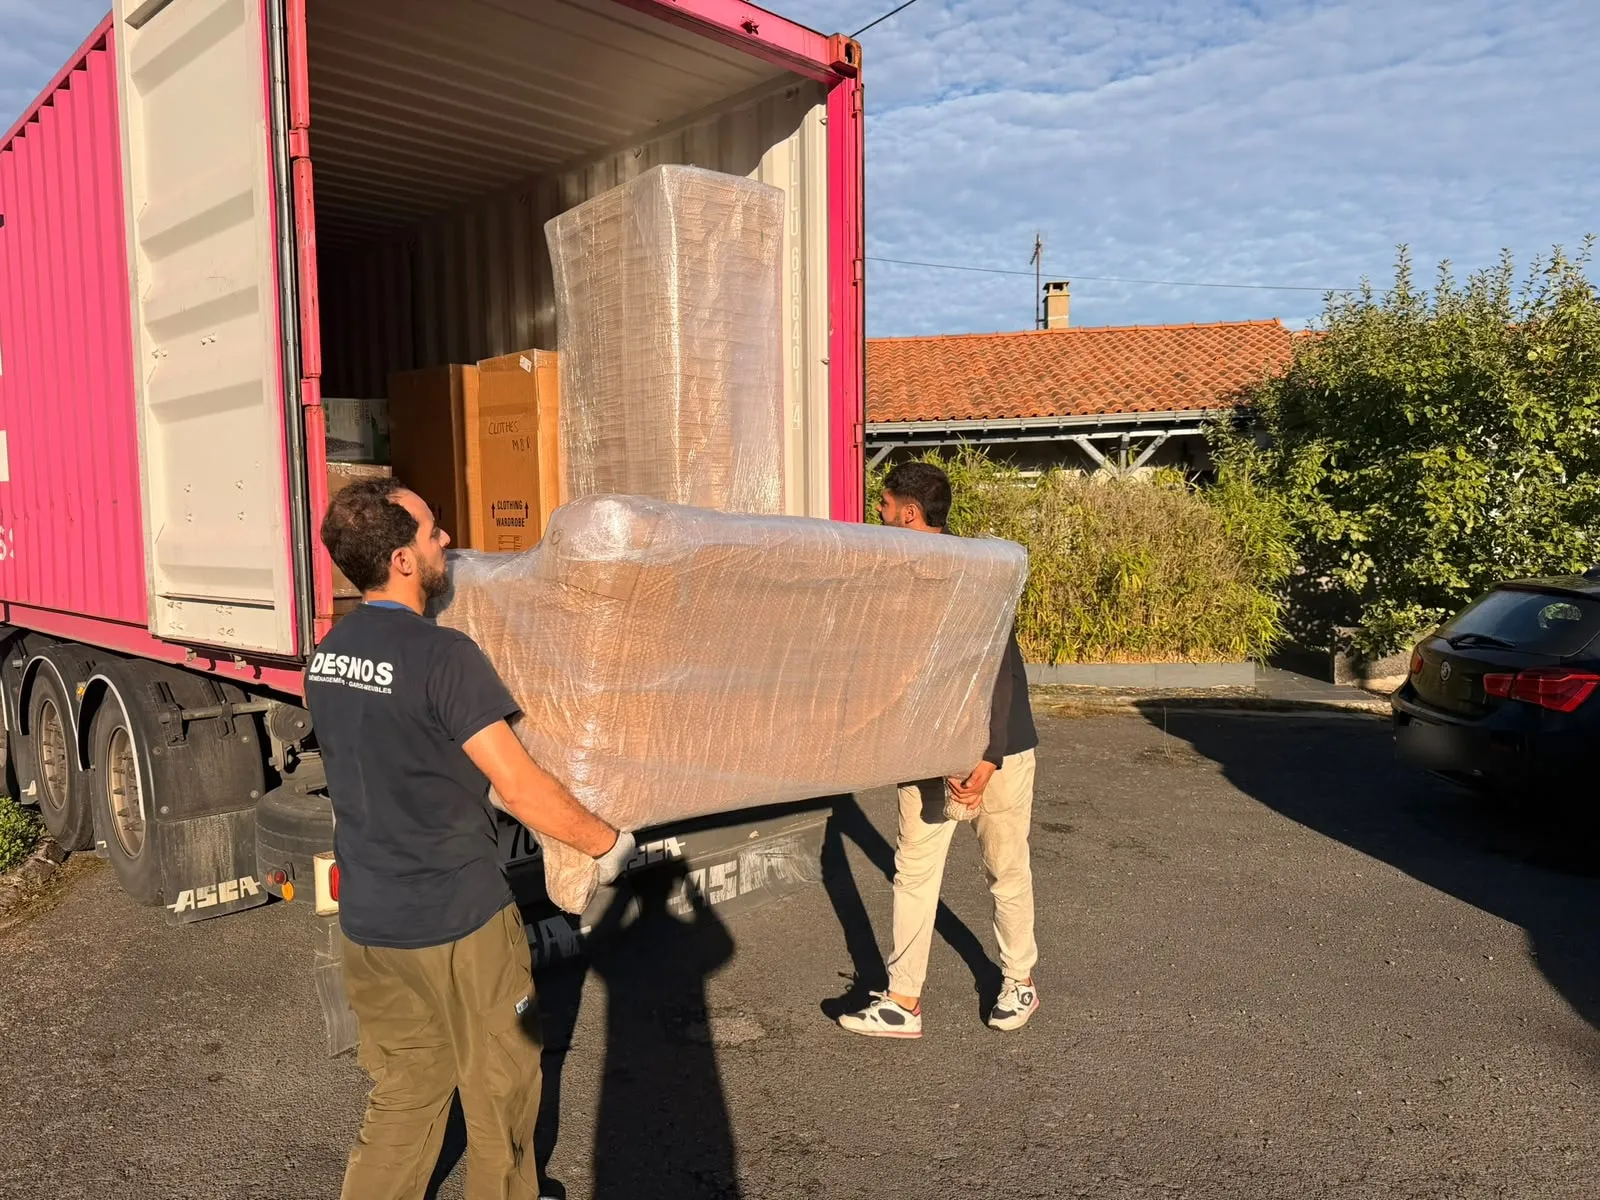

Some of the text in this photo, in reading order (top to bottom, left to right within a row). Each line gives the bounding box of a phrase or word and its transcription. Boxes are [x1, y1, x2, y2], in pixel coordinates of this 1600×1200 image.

[496, 500, 524, 511] CLOTHING
[495, 517, 526, 528] WARDROBE
[309, 652, 394, 686] DESNOS
[167, 875, 262, 913] ASCA
